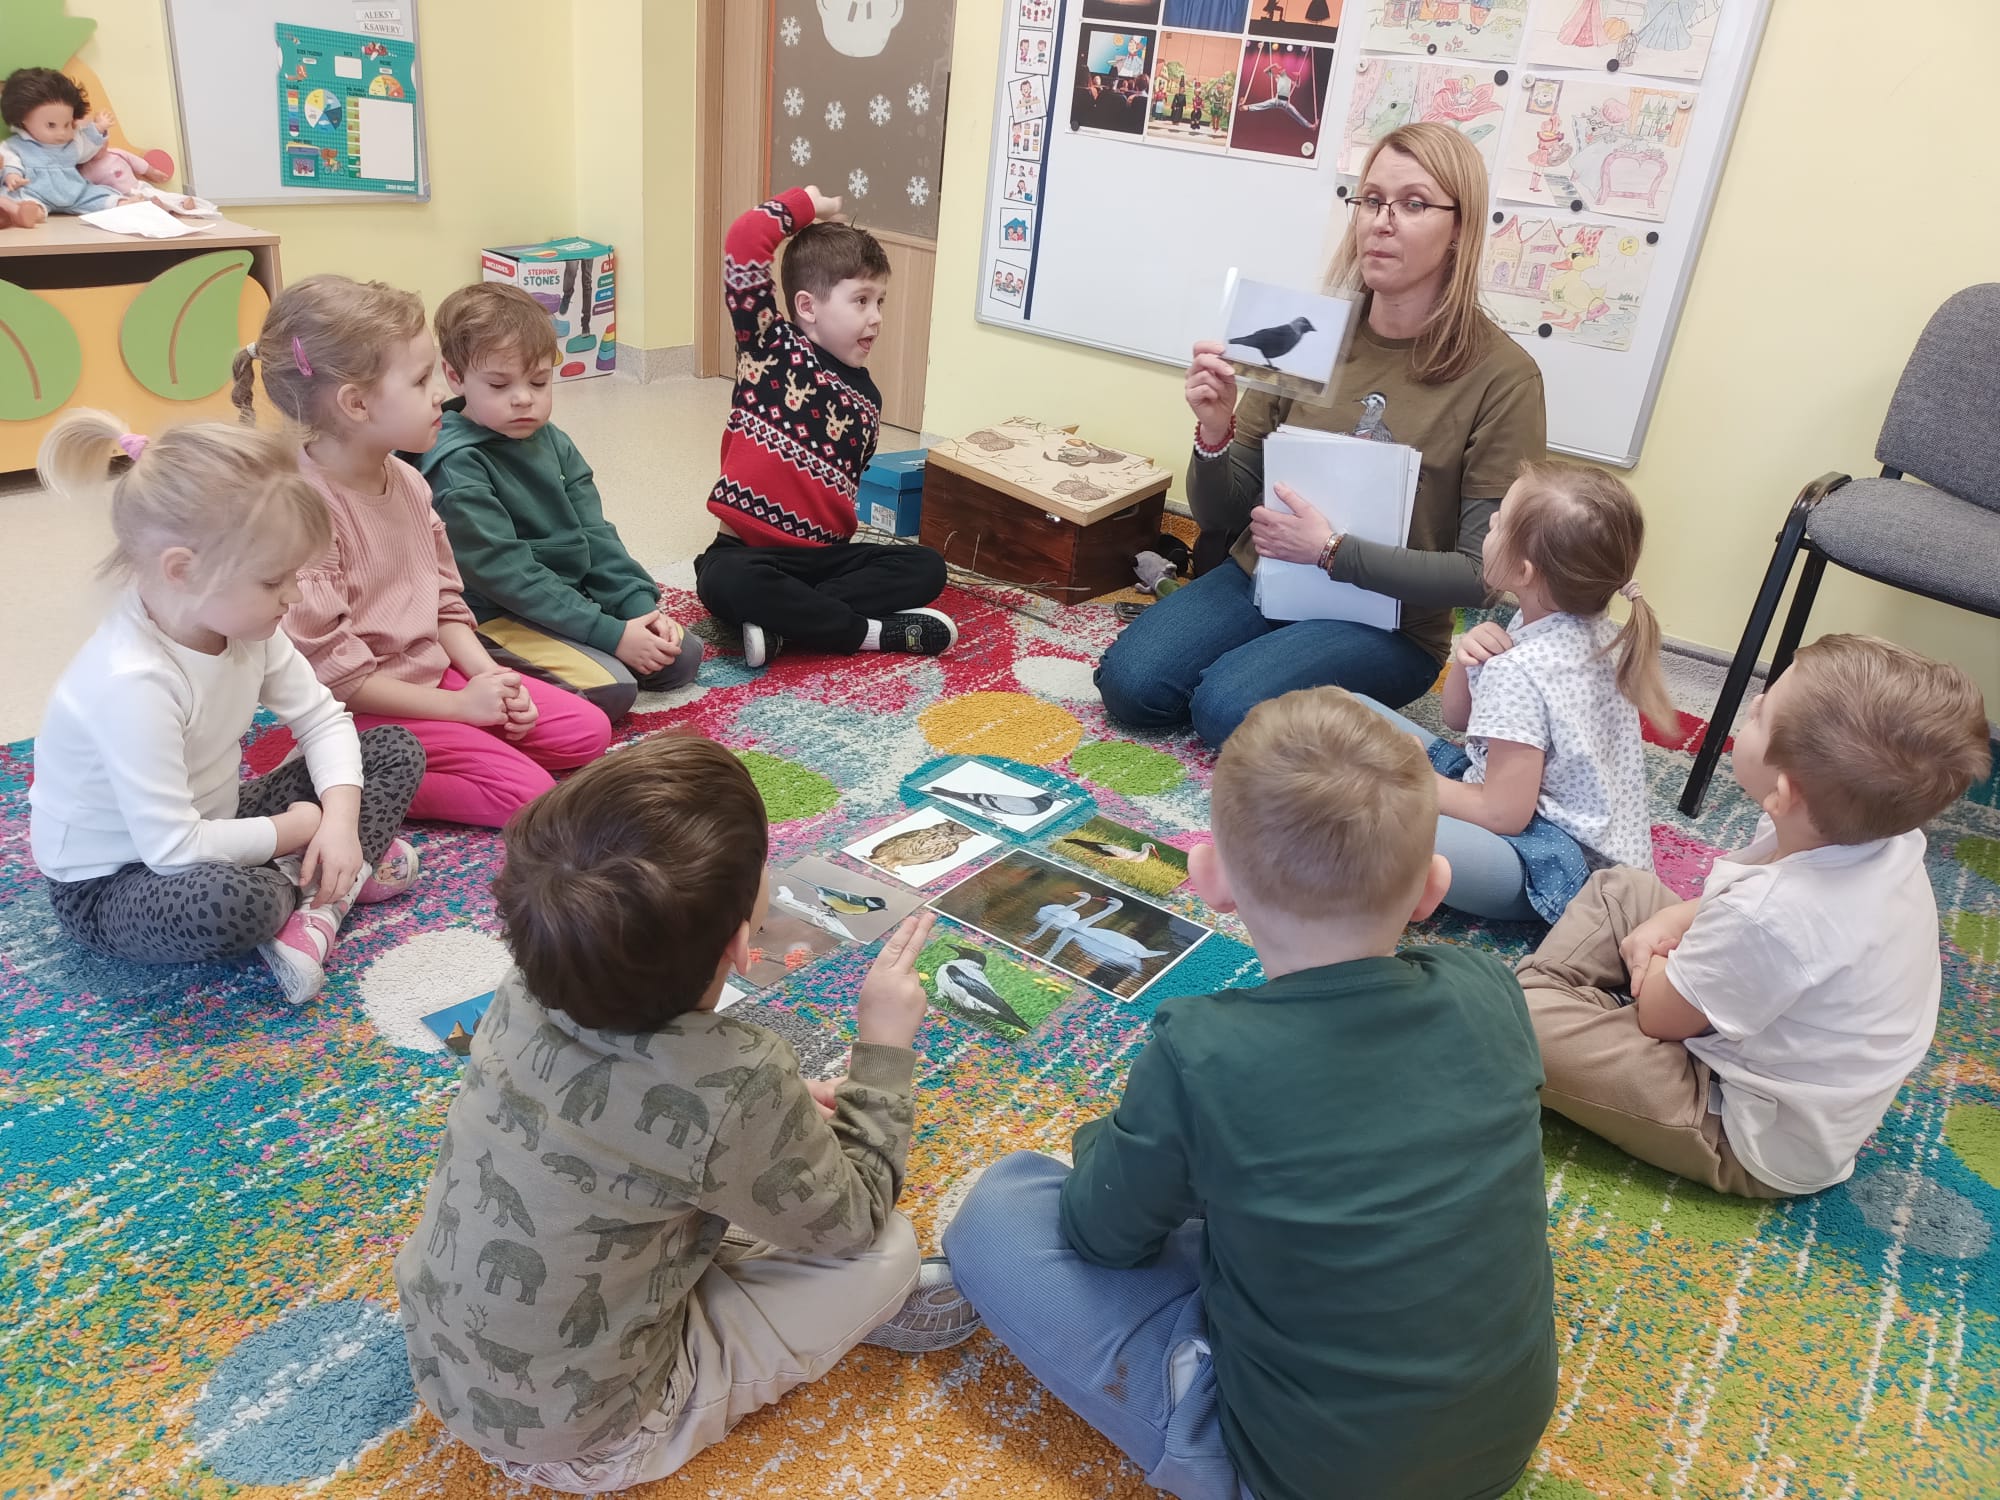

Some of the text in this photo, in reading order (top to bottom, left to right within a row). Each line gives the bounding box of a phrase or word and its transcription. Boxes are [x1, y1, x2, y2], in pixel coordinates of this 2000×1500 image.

[364, 10, 394, 19] ALEKSY
[364, 22, 400, 34] KSAWERY
[527, 268, 558, 276] STEPPING
[523, 275, 560, 287] STONES
